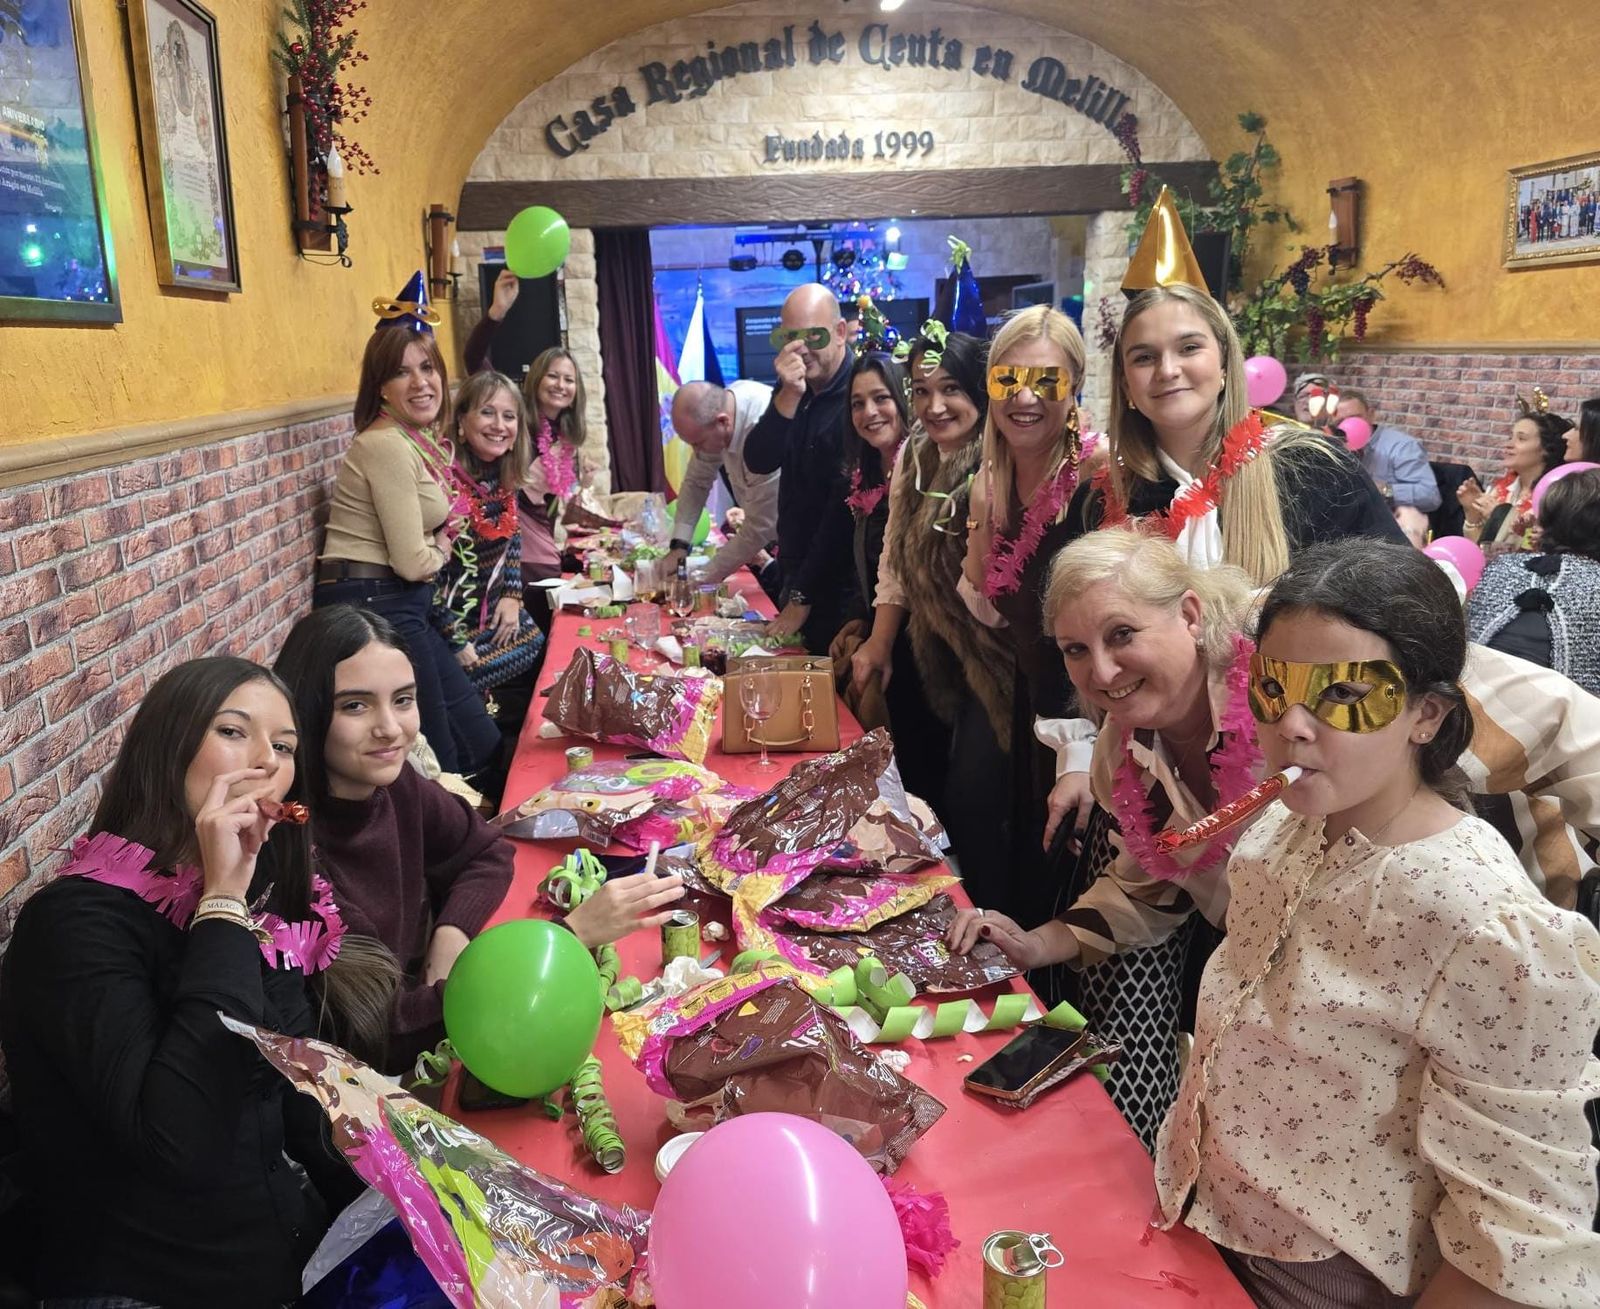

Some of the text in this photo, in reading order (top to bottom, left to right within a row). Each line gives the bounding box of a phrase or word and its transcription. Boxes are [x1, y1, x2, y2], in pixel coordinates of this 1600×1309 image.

[545, 20, 1131, 159] Casa Regional de Ceuta en Melill
[763, 130, 935, 164] Fundada 1999
